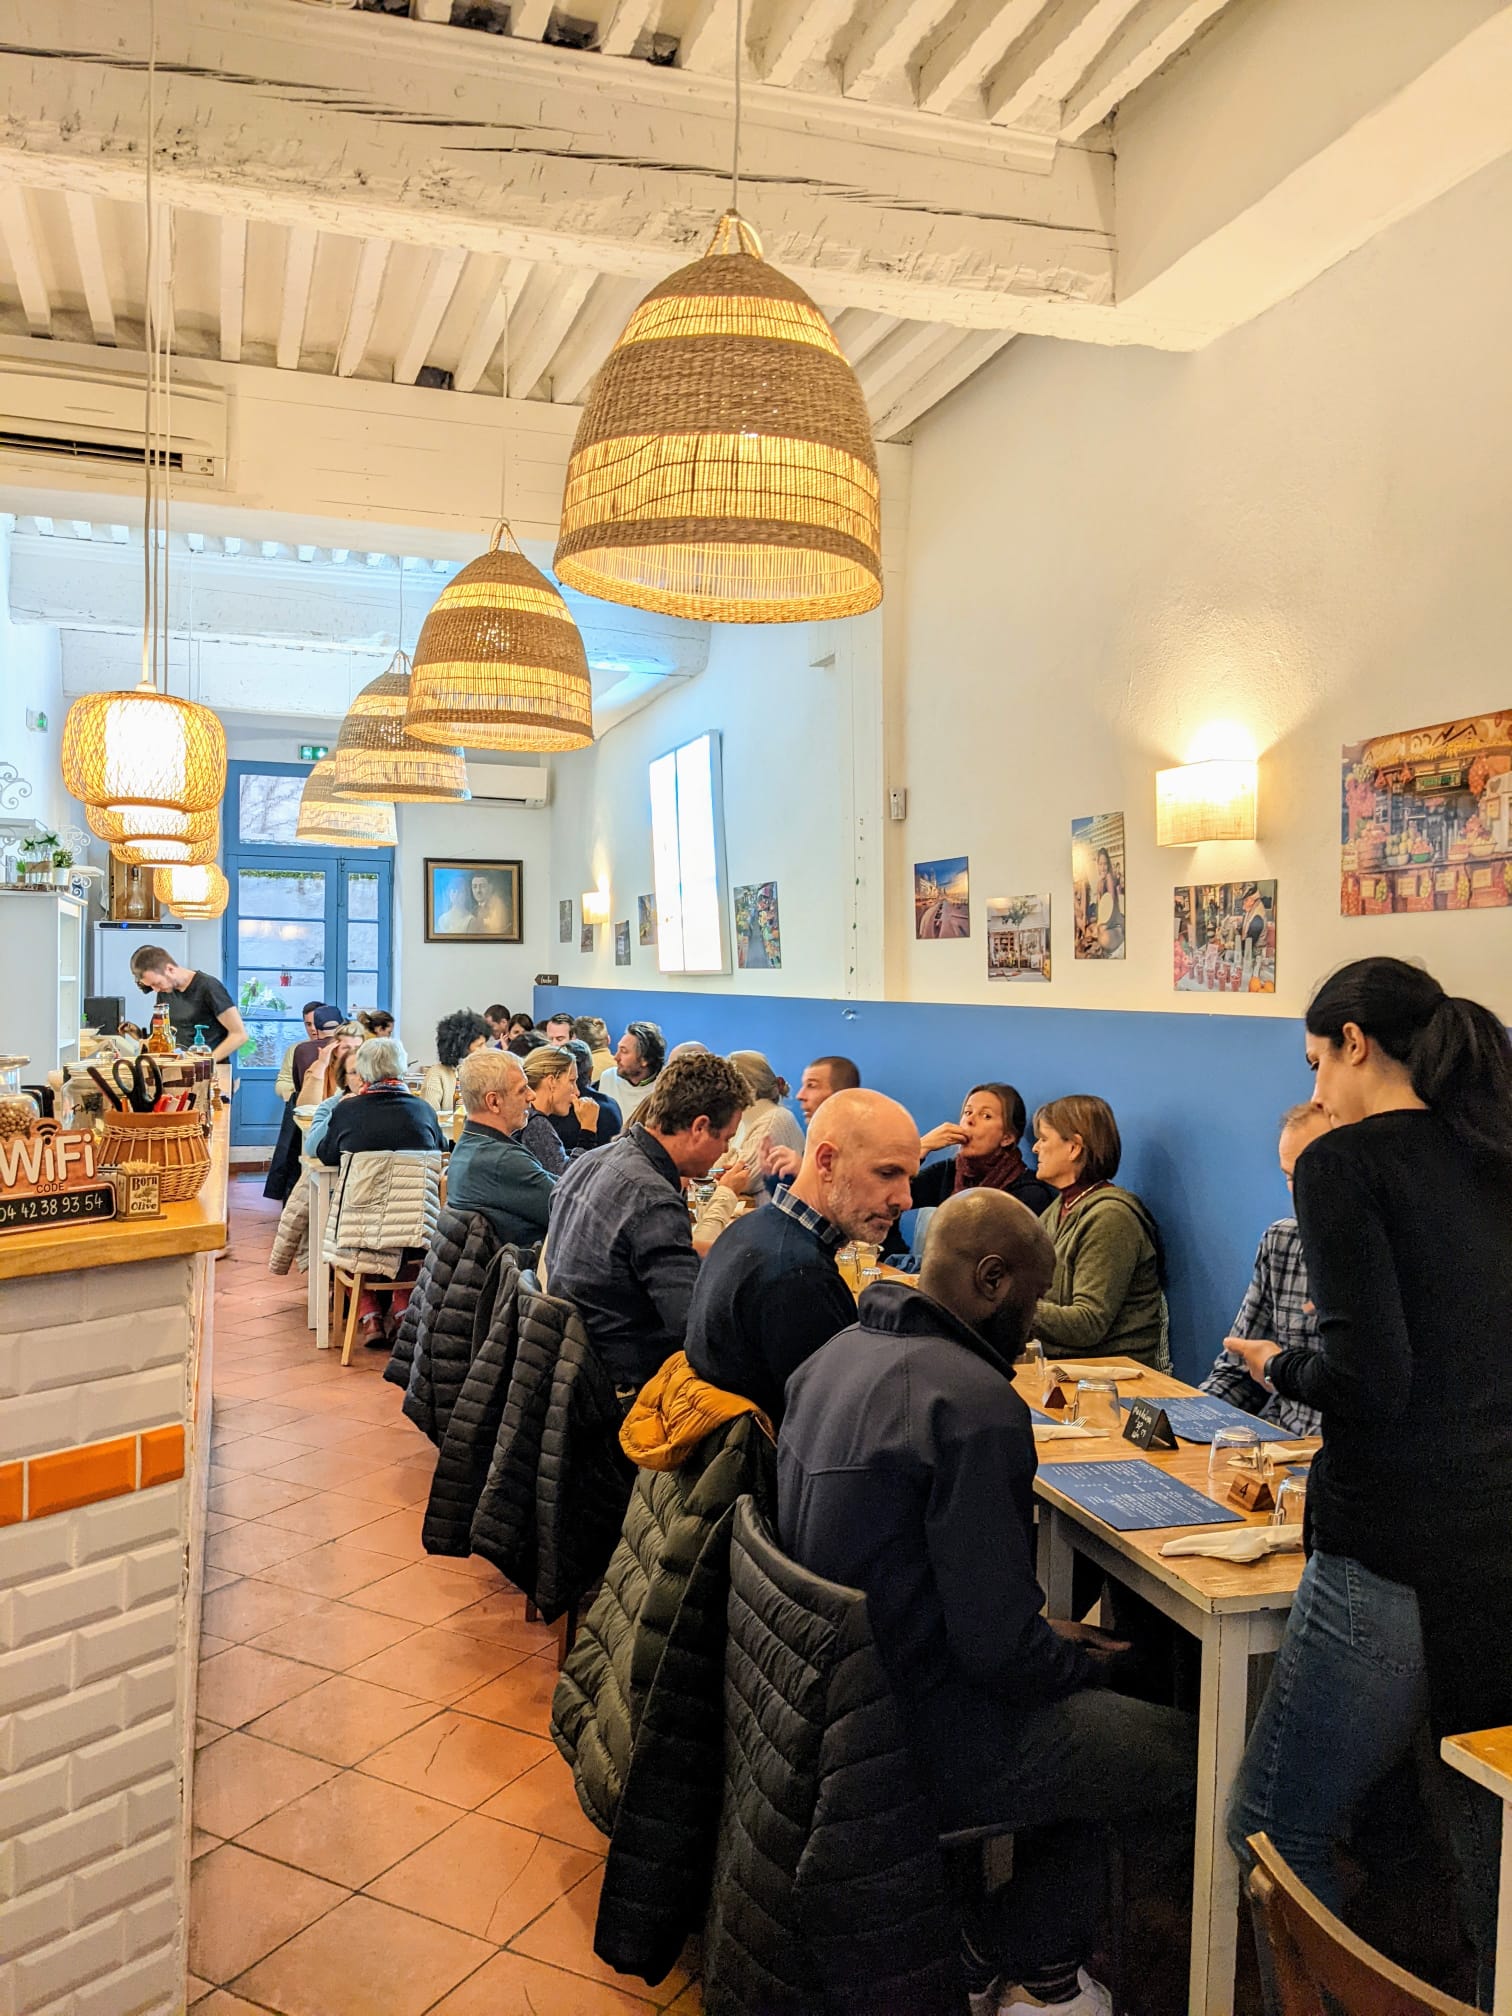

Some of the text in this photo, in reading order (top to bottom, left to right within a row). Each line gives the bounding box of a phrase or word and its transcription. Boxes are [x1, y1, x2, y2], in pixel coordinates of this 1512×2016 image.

[0, 1134, 94, 1187] WiFi
[36, 1182, 65, 1194] CODE
[21, 1202, 38, 1219] 42
[40, 1198, 58, 1216] 38
[62, 1196, 80, 1213] 93
[85, 1193, 104, 1211] 54
[131, 1201, 157, 1211] Olive
[1239, 1482, 1250, 1499] 4
